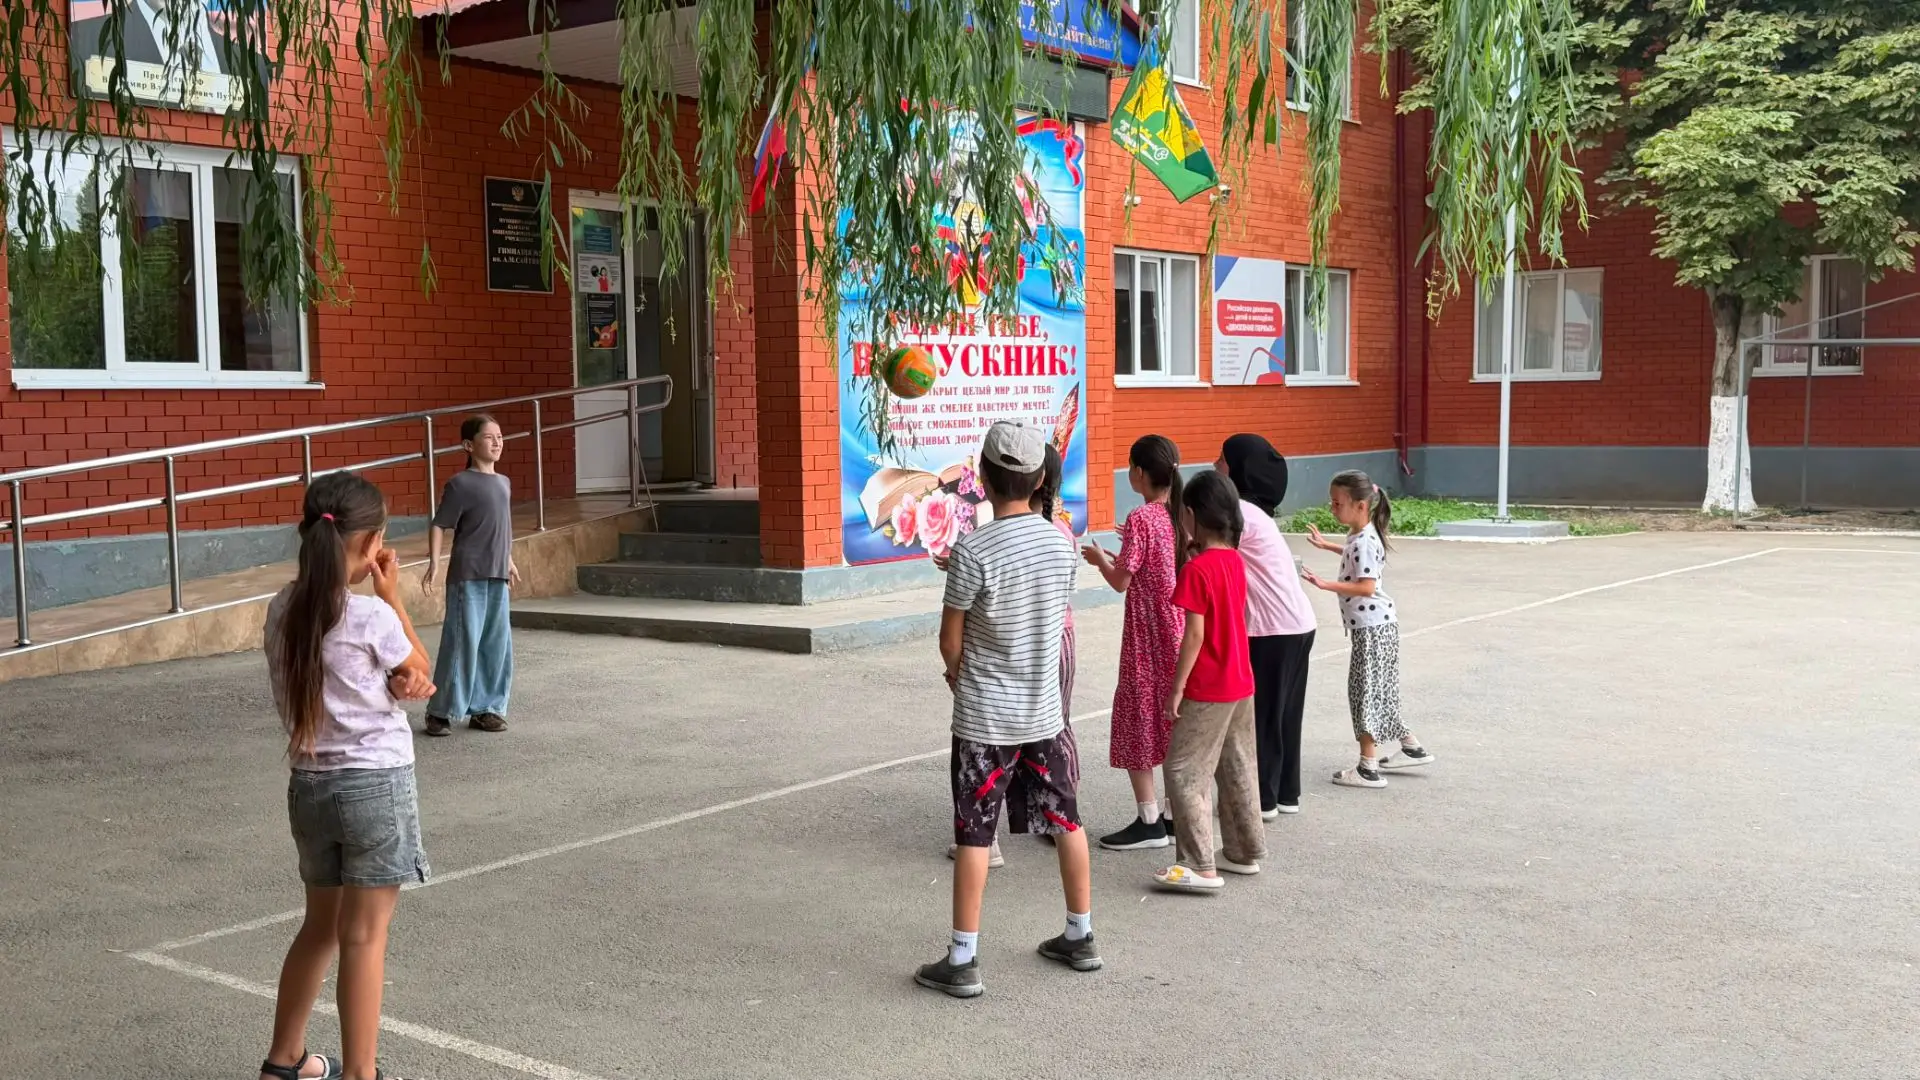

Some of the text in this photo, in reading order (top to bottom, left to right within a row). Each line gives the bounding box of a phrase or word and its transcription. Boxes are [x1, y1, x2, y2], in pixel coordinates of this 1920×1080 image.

[962, 385, 991, 397] ЦЕЛЫЙ
[994, 386, 1010, 396] МИР
[1012, 386, 1030, 396] ДЛЯ
[1032, 385, 1055, 395] ТЕБЯ:
[922, 403, 936, 414] ЖЕ
[940, 403, 973, 413] СМЕЛЕЕ
[976, 402, 1019, 413] НАВСТРЕЧУ
[1022, 401, 1050, 412] МЕЧТЕ!
[927, 418, 976, 430] СМОЖЕШЬ!
